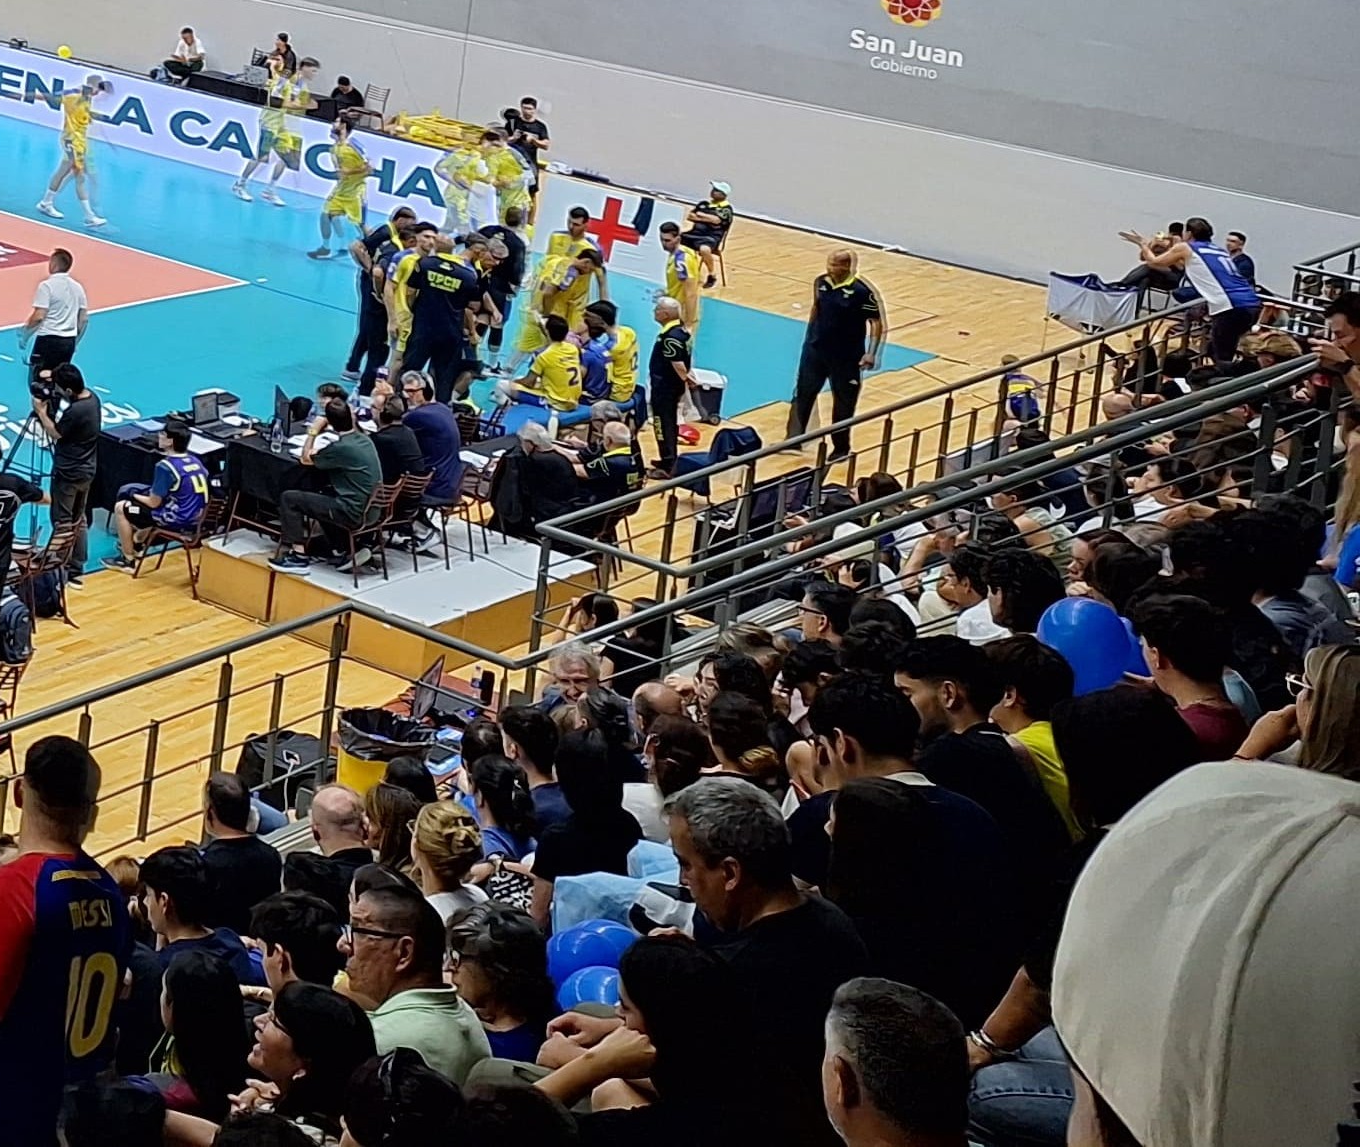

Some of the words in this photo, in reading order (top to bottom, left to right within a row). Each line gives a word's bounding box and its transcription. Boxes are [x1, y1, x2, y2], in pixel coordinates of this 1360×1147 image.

[849, 29, 896, 54] San
[901, 39, 963, 67] Juan
[870, 56, 938, 80] Gobierno
[427, 270, 462, 290] UPCN
[567, 366, 580, 386] 2
[190, 473, 209, 504] 4
[64, 952, 118, 1058] 10
